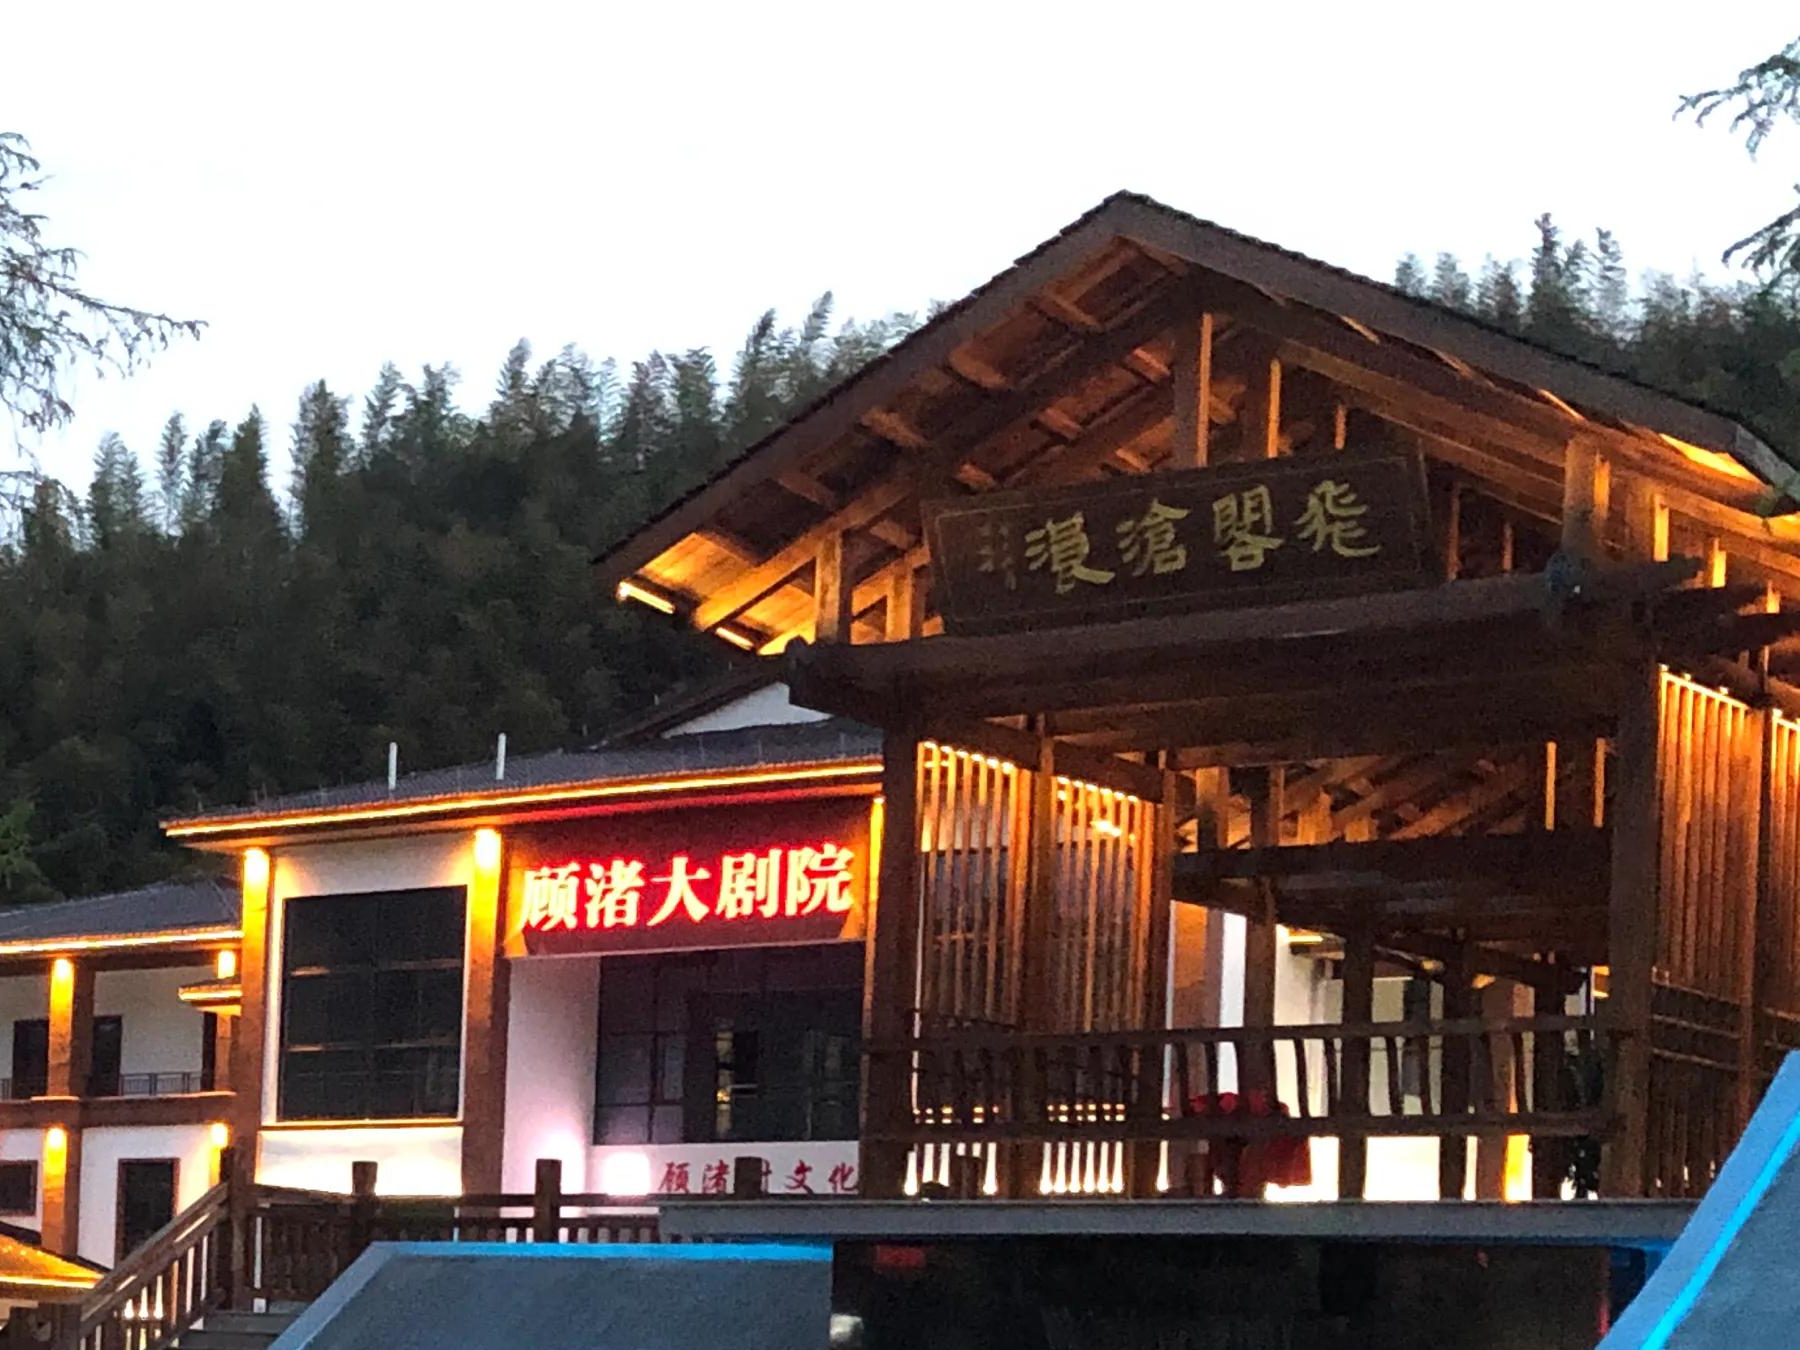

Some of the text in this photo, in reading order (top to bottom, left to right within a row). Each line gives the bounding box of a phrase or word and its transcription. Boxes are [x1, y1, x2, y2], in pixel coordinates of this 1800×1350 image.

[518, 843, 856, 932] 顾渚大剧院
